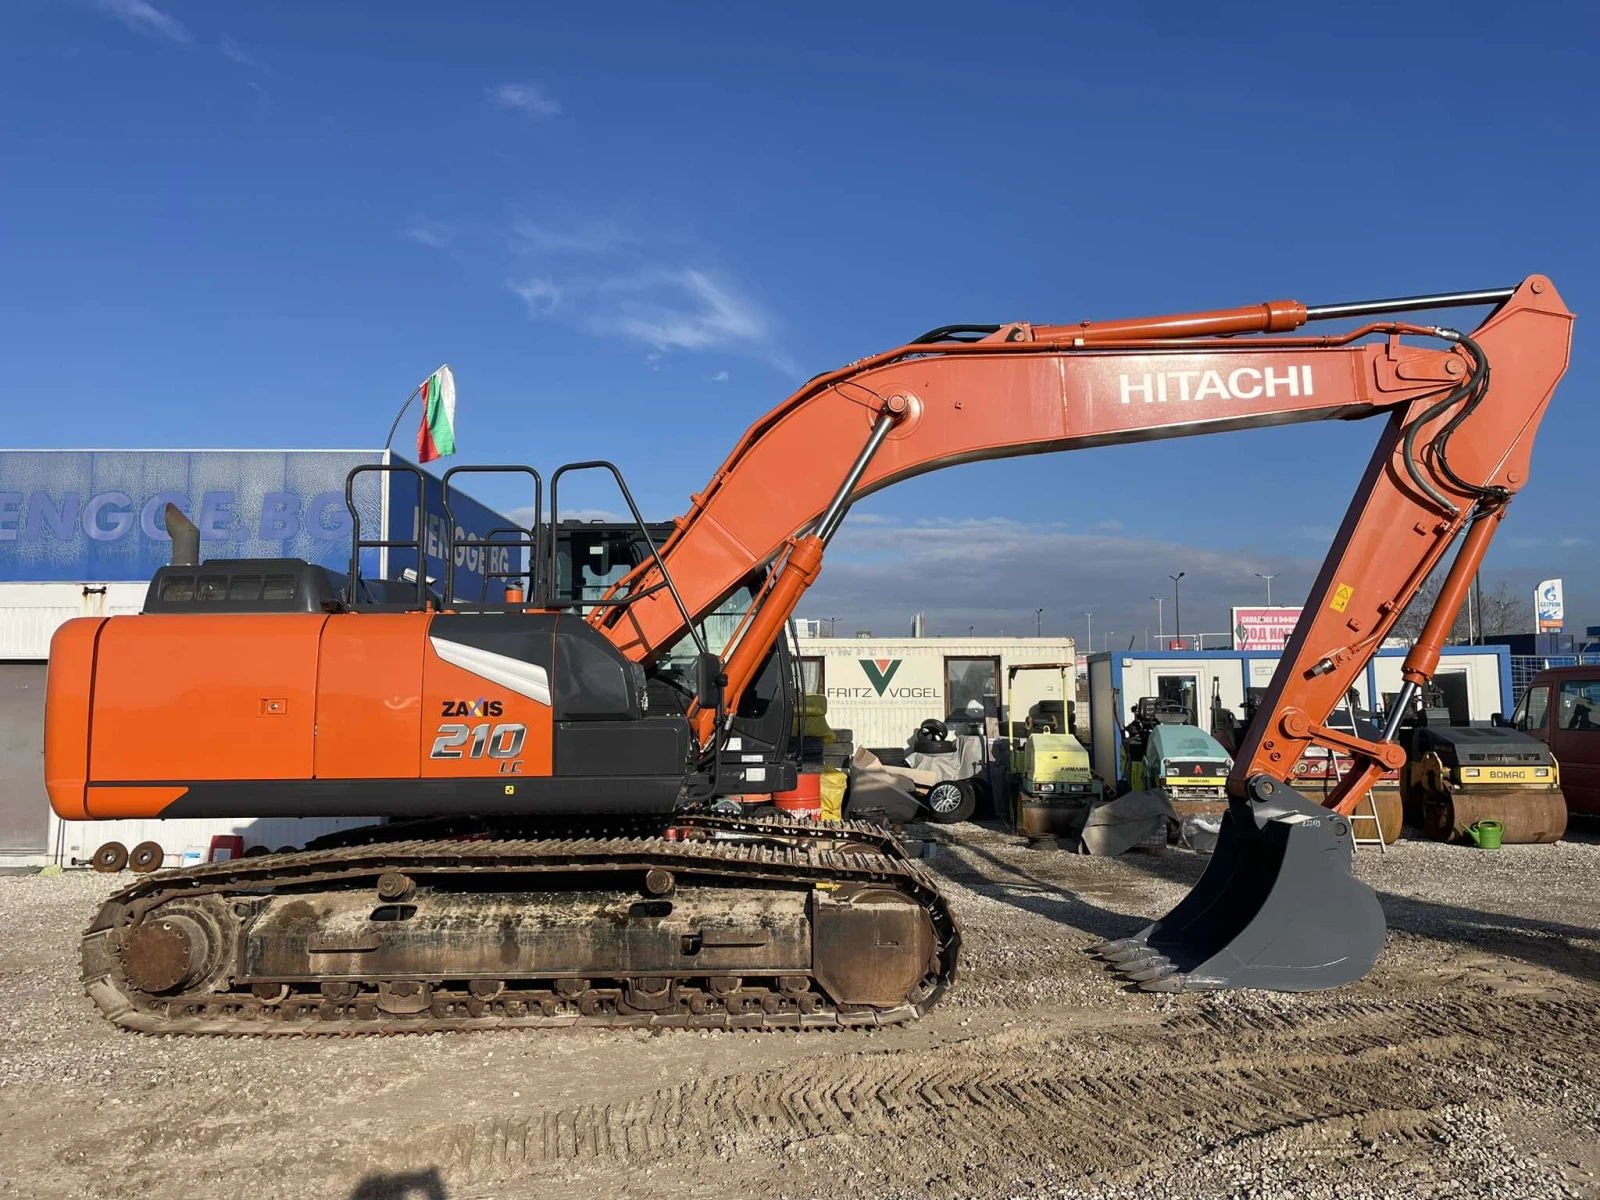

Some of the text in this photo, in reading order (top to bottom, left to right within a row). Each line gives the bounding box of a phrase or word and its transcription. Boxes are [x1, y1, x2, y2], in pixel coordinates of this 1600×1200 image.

[1119, 364, 1313, 404] HITACHI
[827, 688, 942, 698] FRITZ VOGEL
[441, 697, 504, 717] ZAXIS
[430, 723, 527, 759] 210
[499, 760, 525, 774] LC
[1490, 771, 1526, 779] BOMAG
